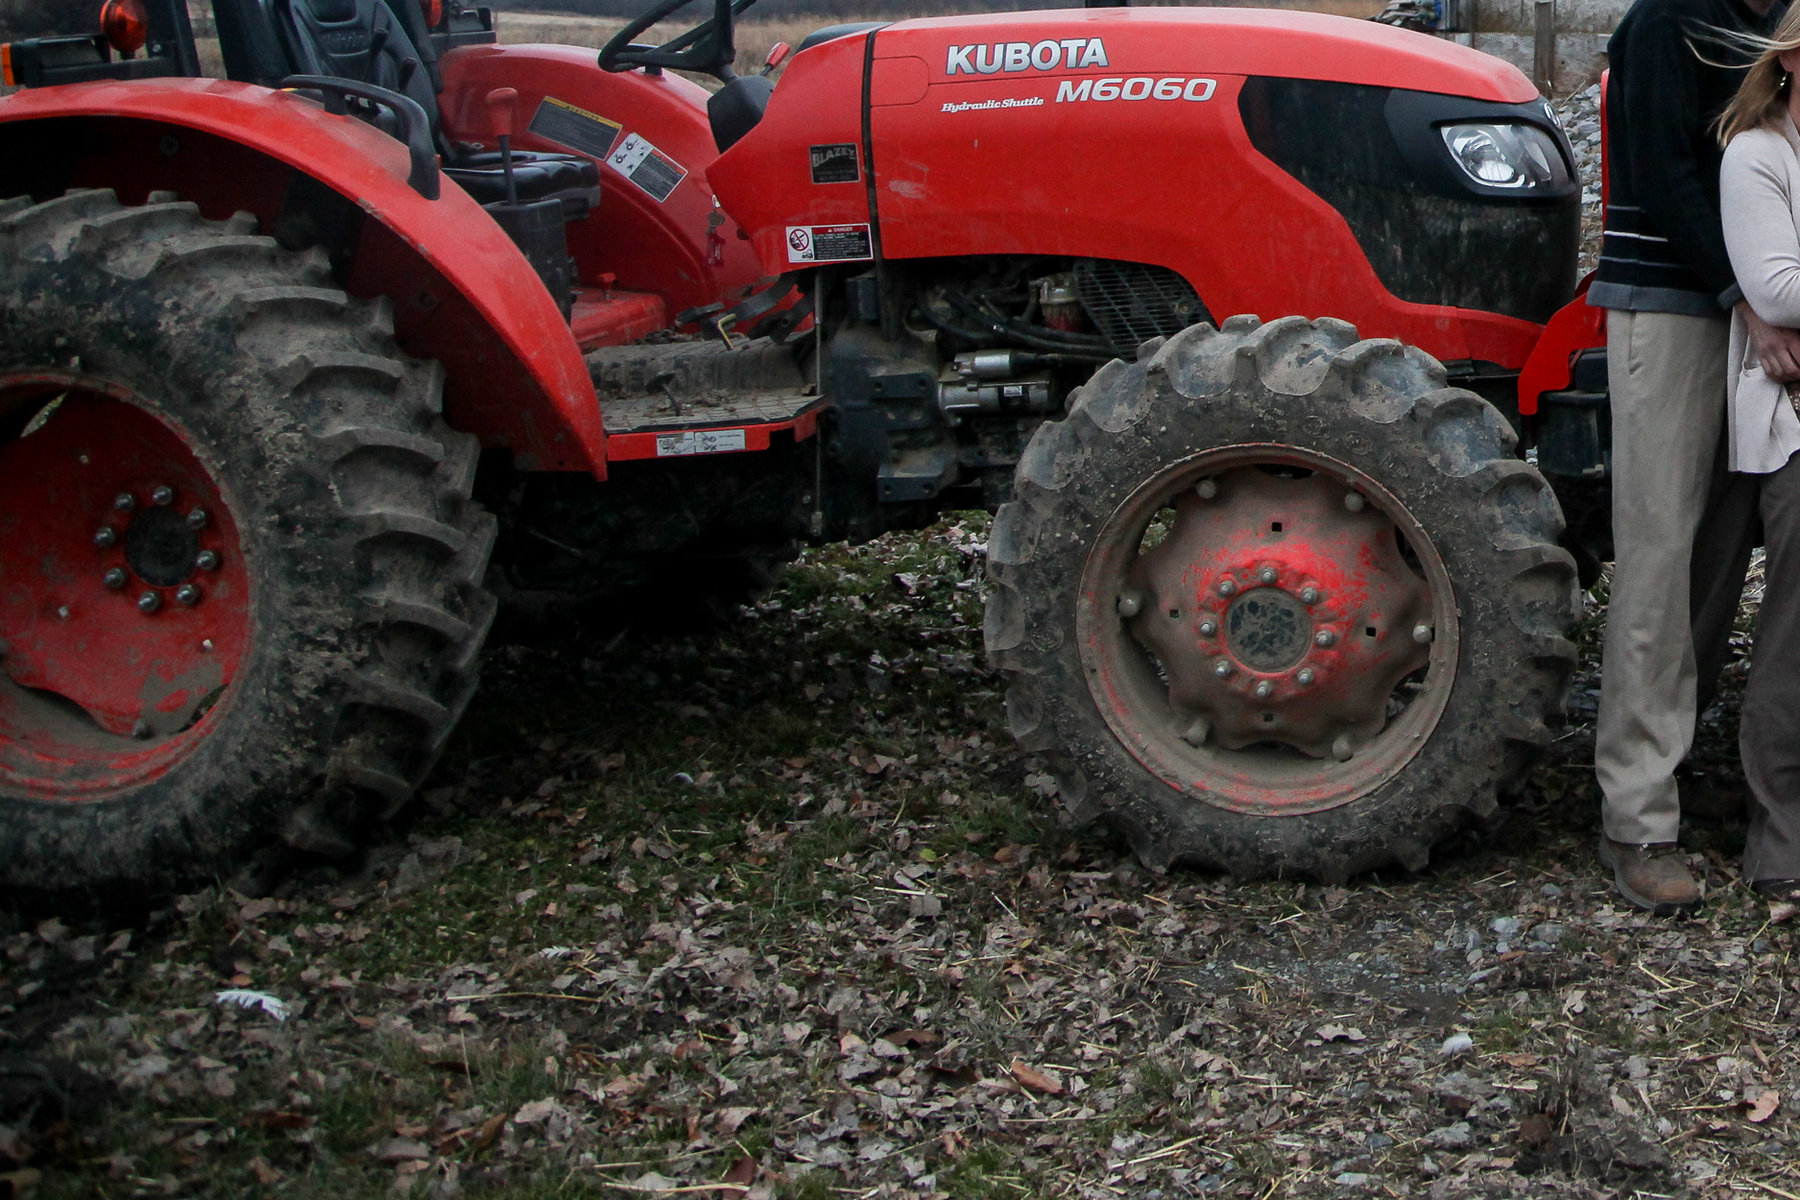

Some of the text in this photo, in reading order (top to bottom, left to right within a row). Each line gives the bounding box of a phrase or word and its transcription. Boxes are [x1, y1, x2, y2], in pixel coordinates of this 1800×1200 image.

[946, 37, 1109, 75] KUBOTA
[1055, 77, 1217, 103] M6060
[941, 96, 1044, 113] Hydraulic Shuttle
